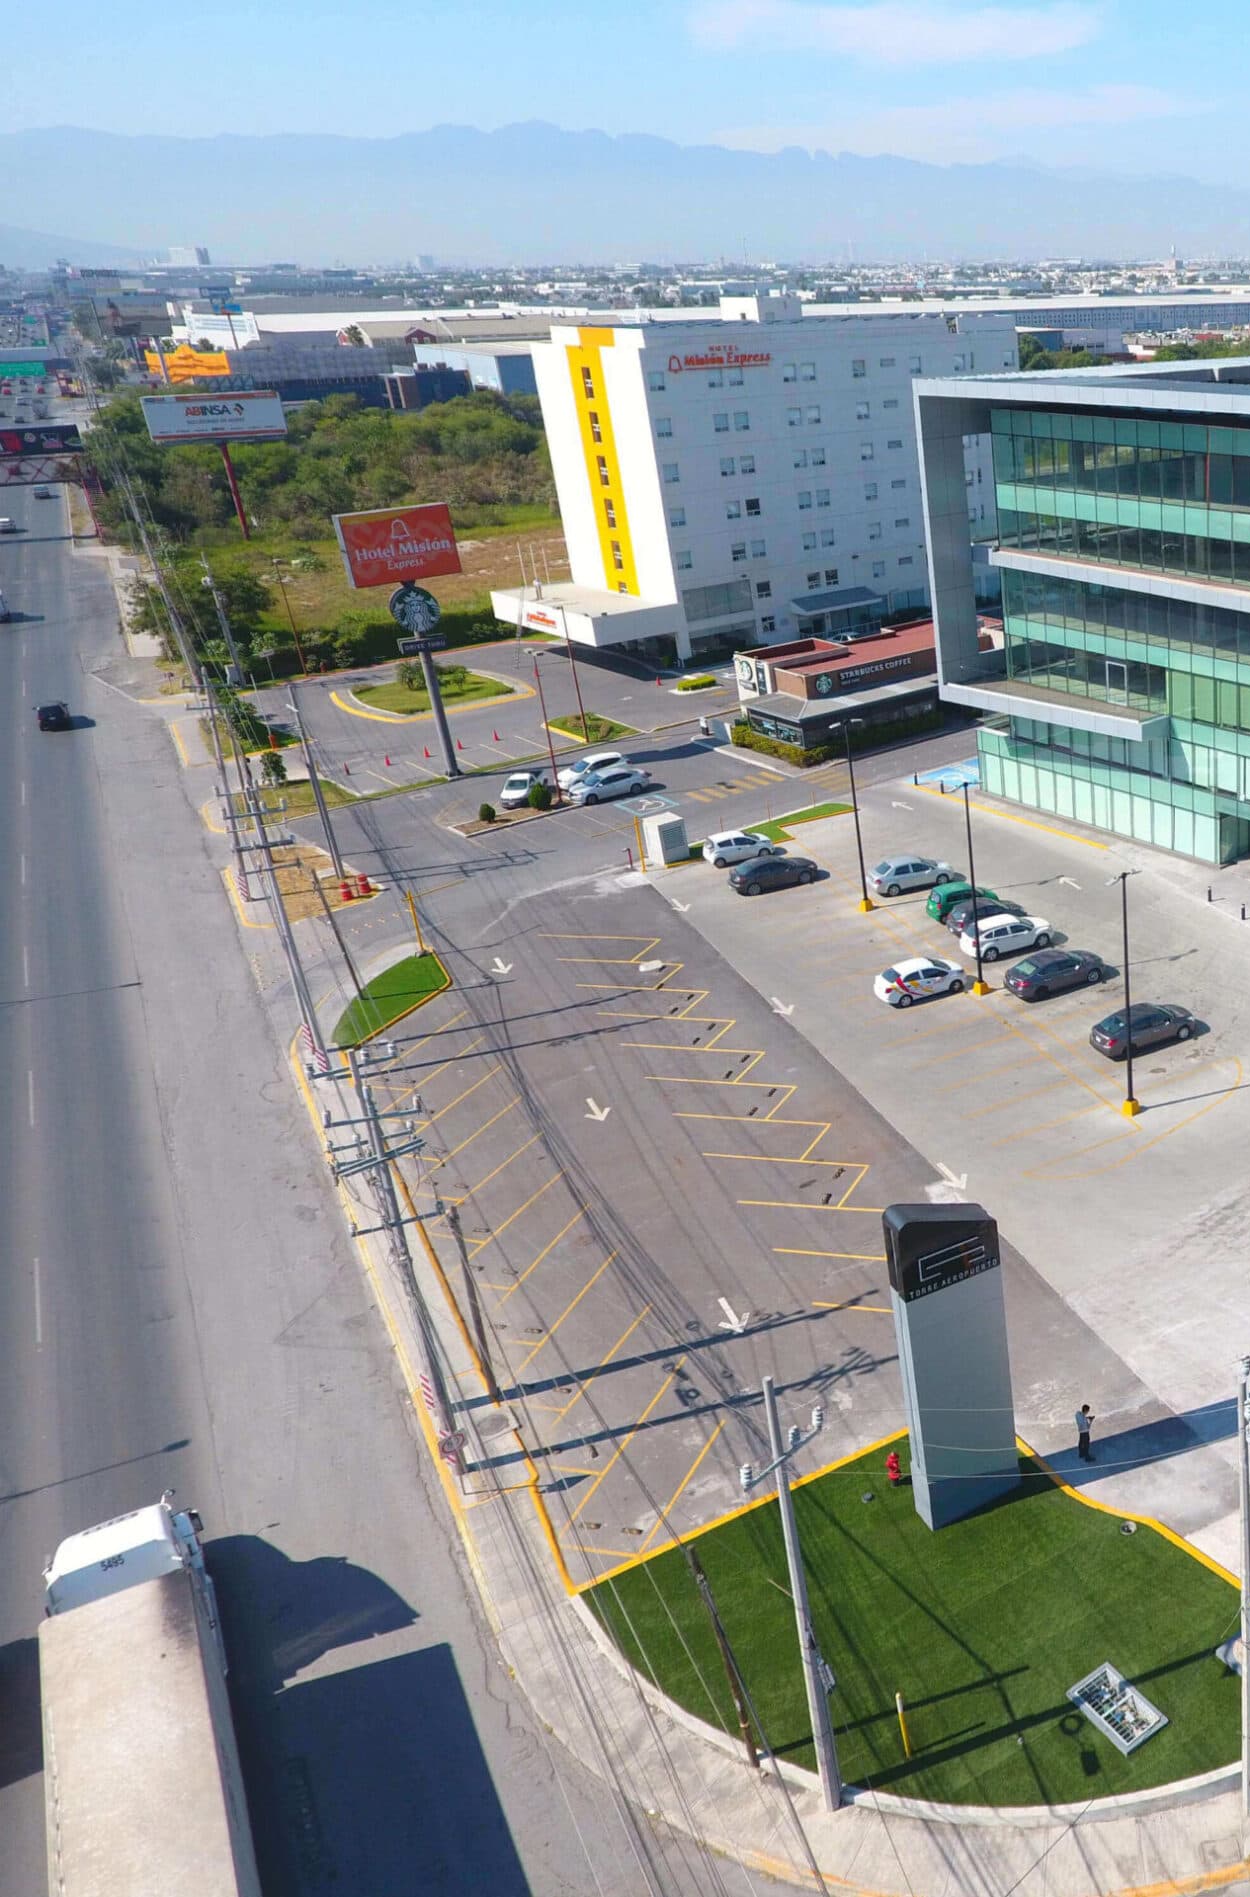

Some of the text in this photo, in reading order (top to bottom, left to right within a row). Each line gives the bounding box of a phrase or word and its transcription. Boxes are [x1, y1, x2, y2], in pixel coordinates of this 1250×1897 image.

[726, 352, 771, 367] Express
[185, 404, 231, 417] ABINSA
[355, 536, 450, 562] Hotel Misión
[387, 557, 424, 571] Express
[840, 657, 912, 680] STARBUCKS COFFEE
[909, 1258, 998, 1299] TORRE AEROPUERTO
